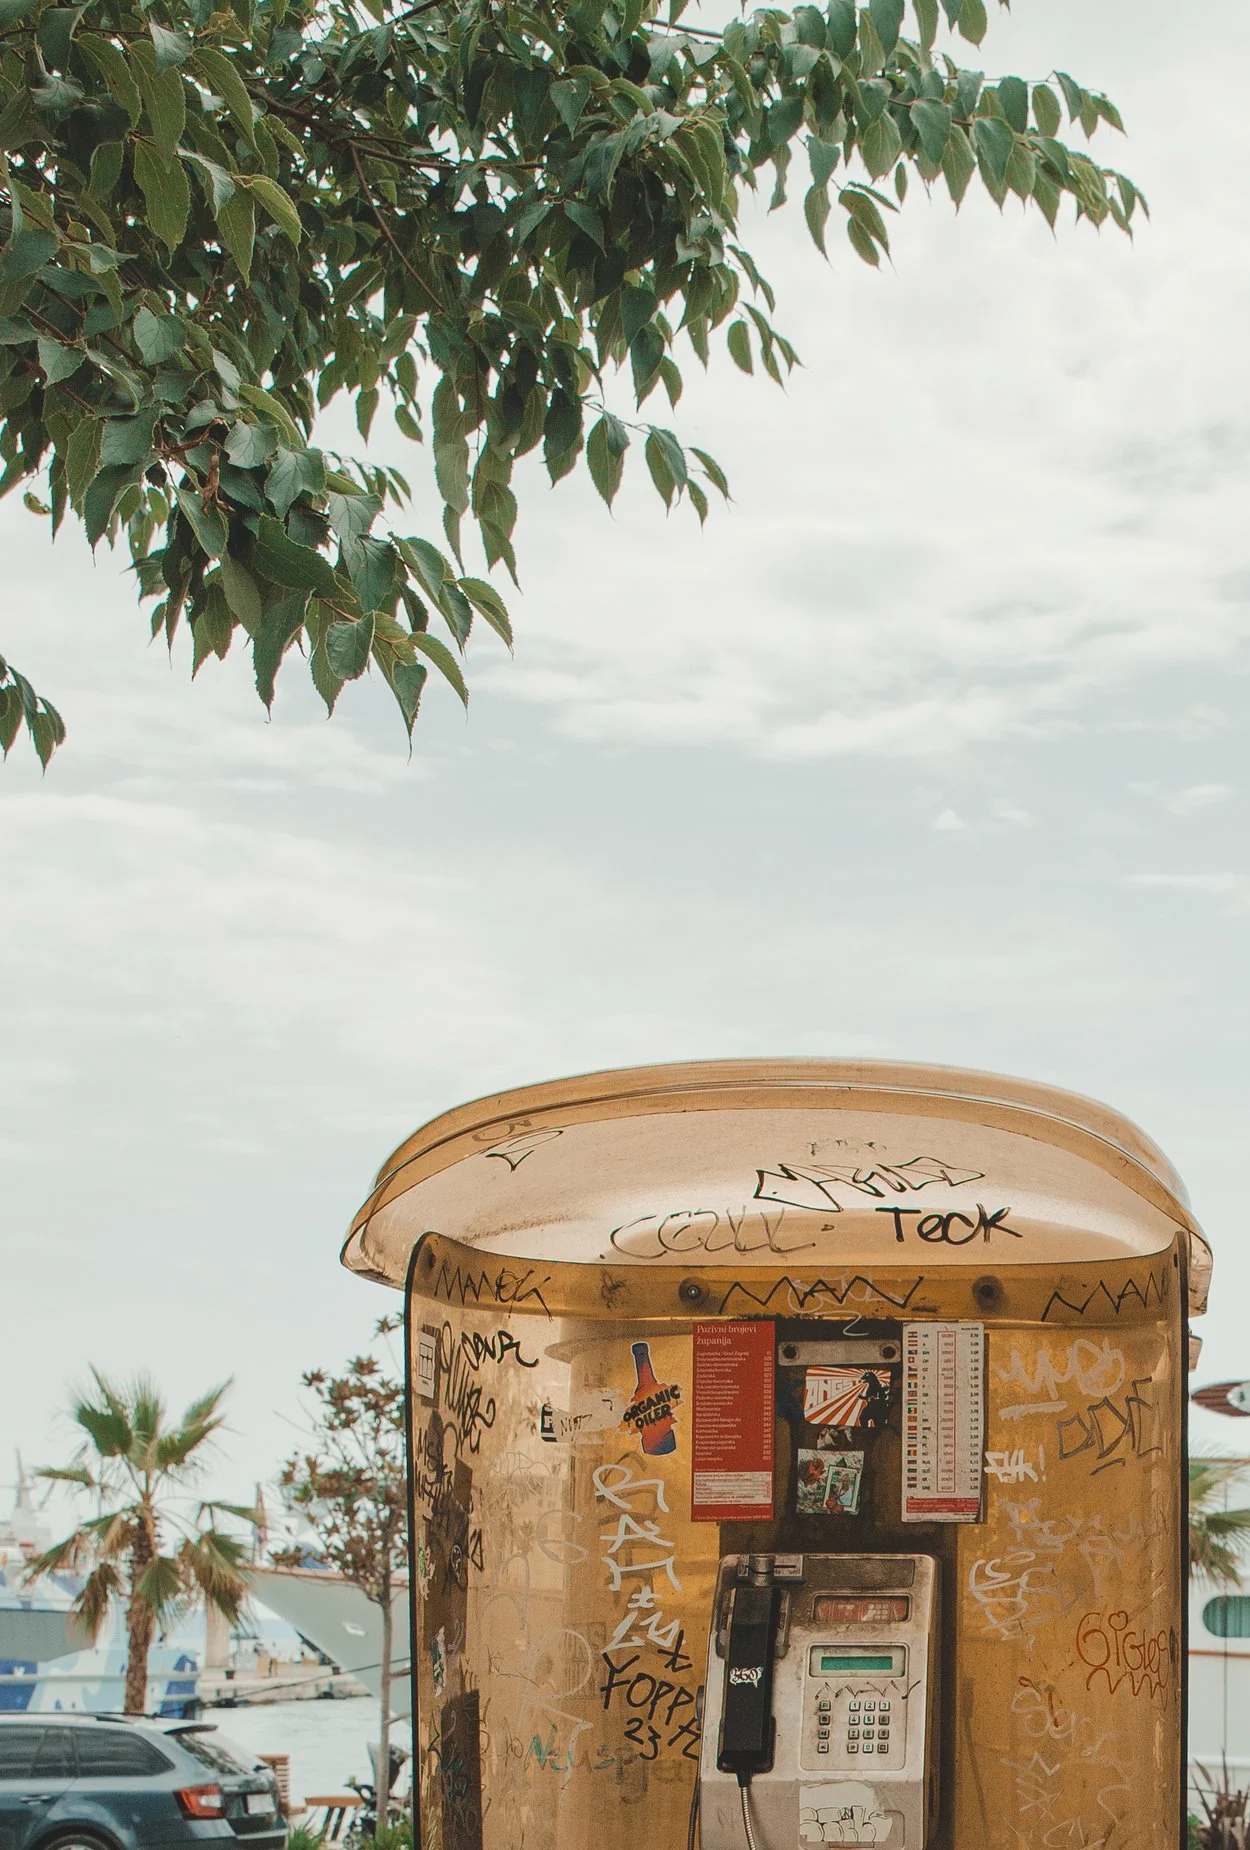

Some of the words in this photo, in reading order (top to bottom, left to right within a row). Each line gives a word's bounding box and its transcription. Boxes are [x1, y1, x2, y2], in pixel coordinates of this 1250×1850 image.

[696, 1325, 727, 1334] Pozivni
[728, 1325, 757, 1335] brojevi
[696, 1336, 732, 1346] županija
[622, 1384, 682, 1422] ORGANIC
[634, 1402, 674, 1429] OILER
